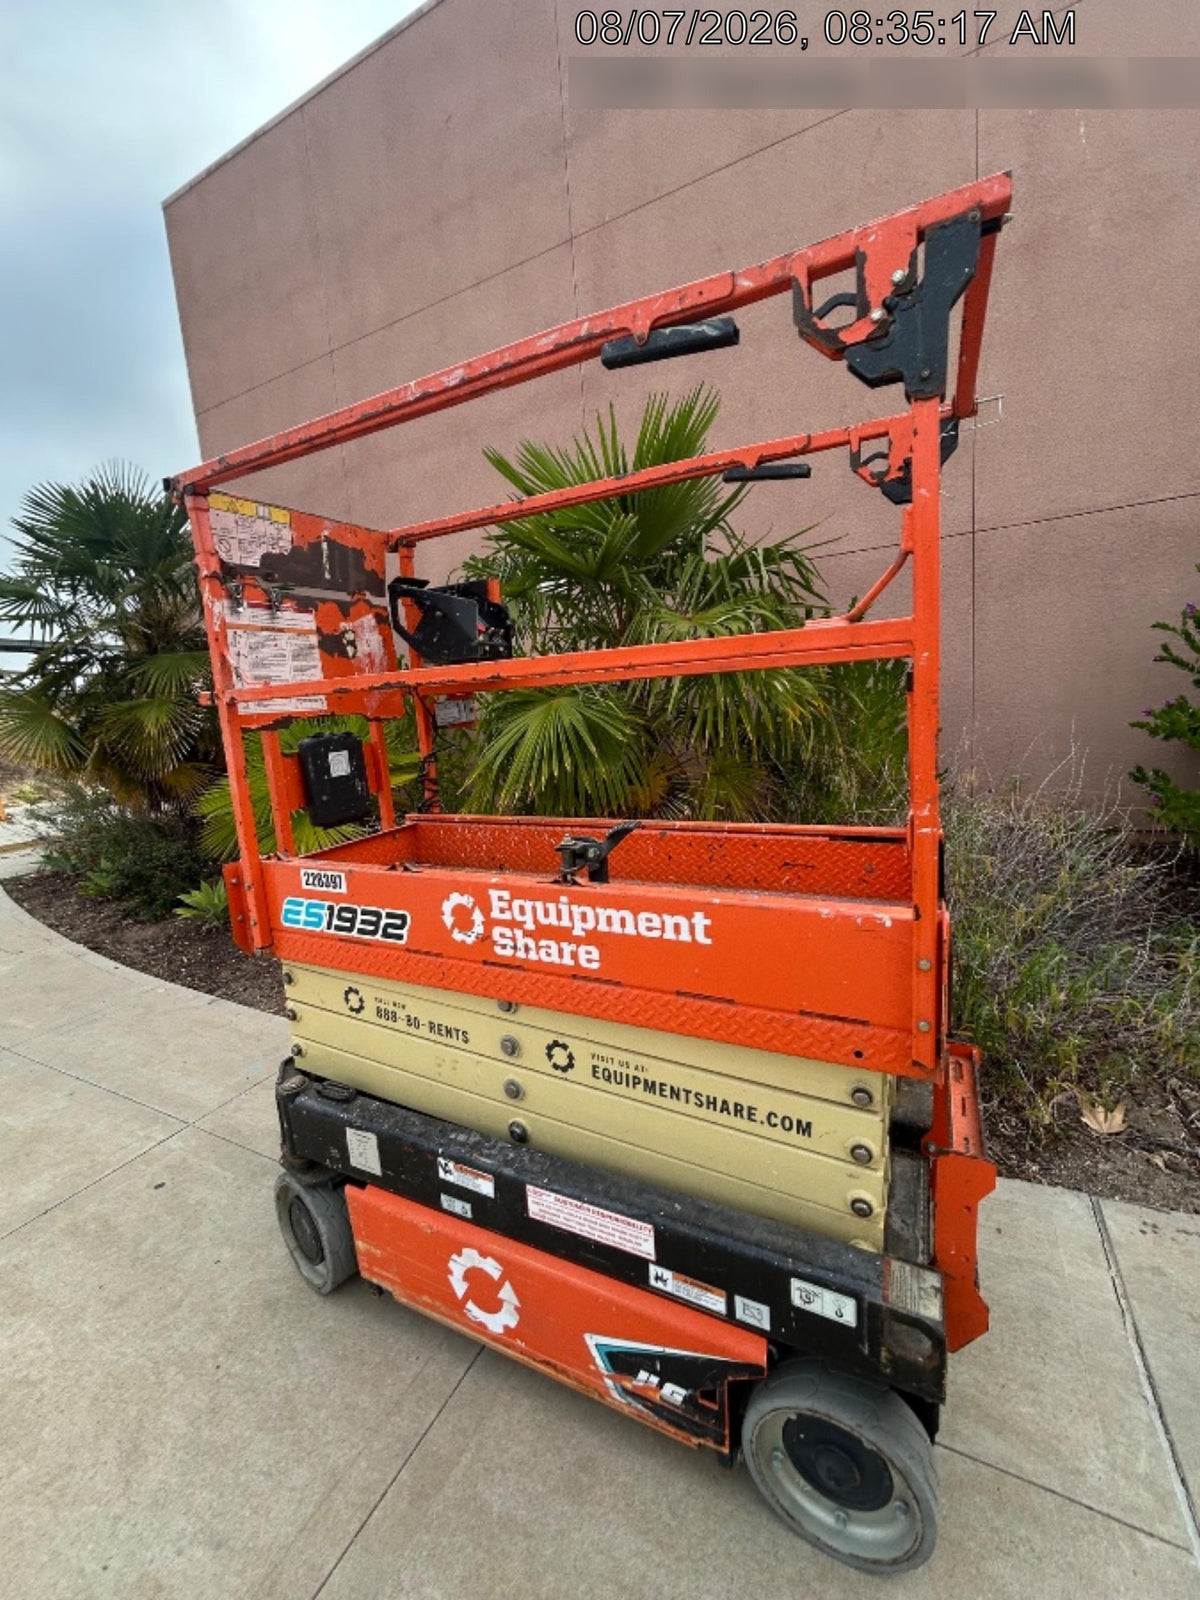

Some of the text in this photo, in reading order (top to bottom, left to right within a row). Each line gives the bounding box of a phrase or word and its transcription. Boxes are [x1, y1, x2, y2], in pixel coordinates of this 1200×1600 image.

[282, 898, 409, 943] ES1932
[488, 889, 712, 944] Equipment
[492, 926, 601, 969] Share
[591, 1053, 615, 1066] VISIT
[618, 1060, 630, 1069] US
[591, 1064, 813, 1138] EQUIPMENTSHARE.COM
